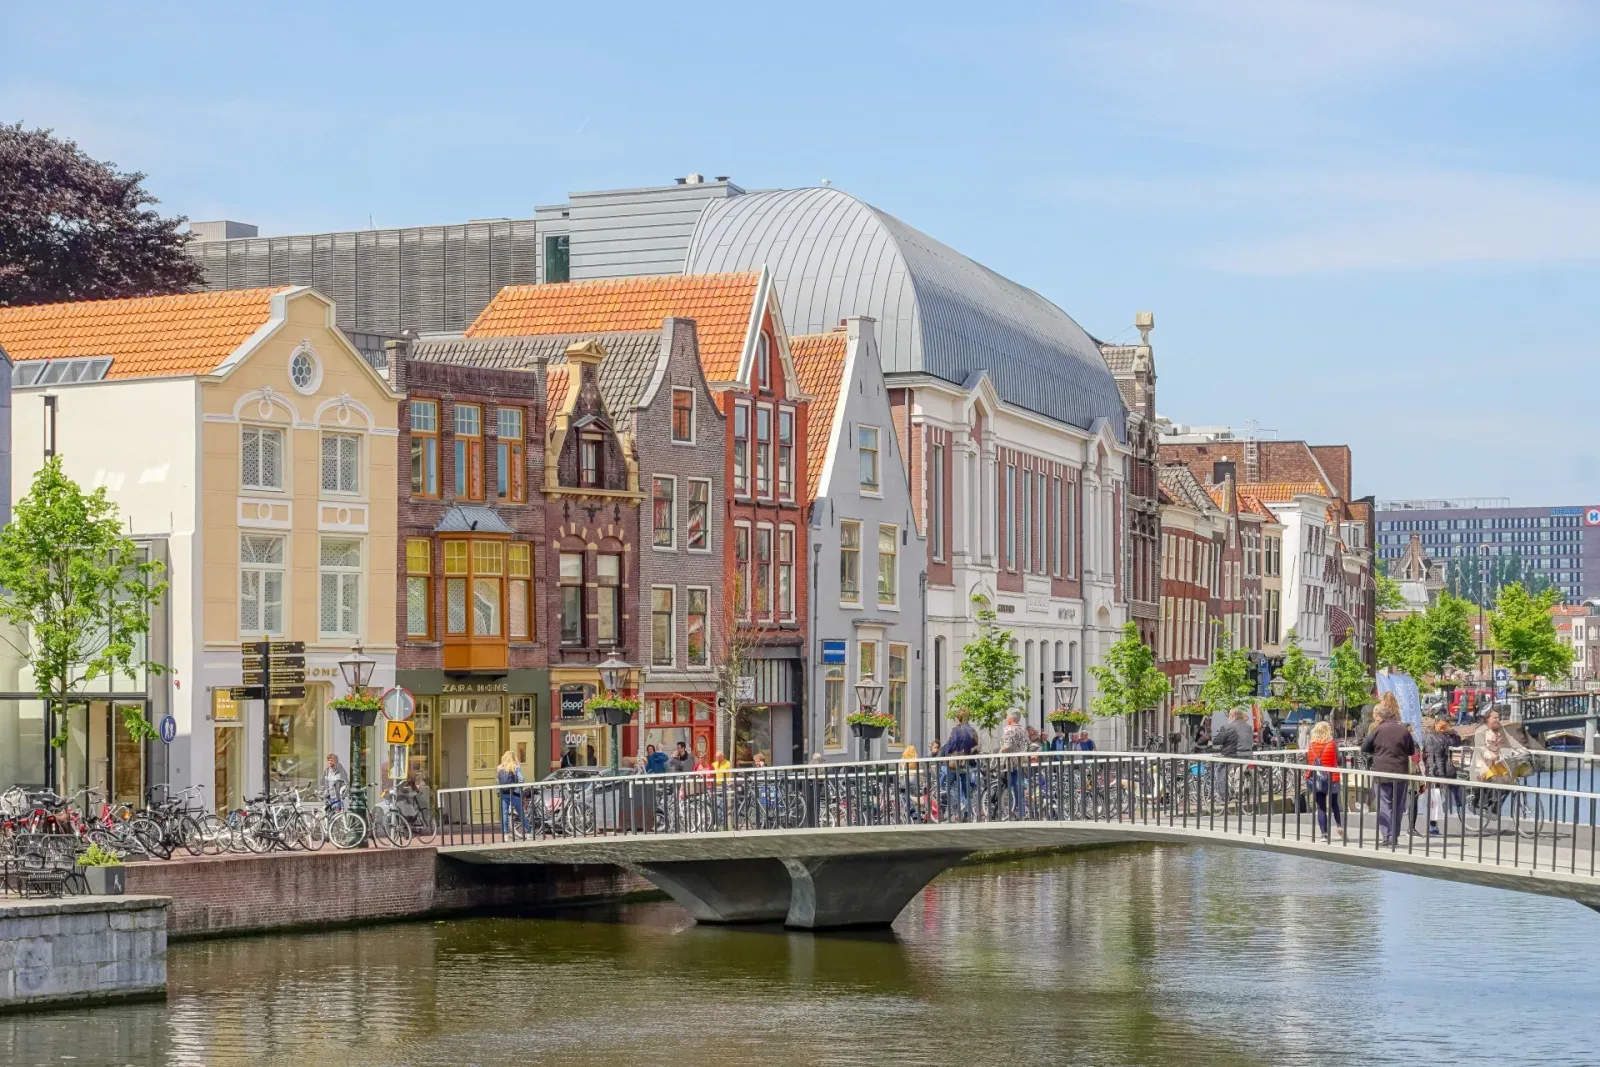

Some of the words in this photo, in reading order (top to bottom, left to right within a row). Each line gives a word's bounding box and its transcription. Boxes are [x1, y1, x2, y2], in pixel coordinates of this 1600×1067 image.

[442, 683, 474, 693] ZARA
[476, 683, 509, 692] HOME
[562, 699, 583, 710] dapp
[392, 726, 402, 738] A
